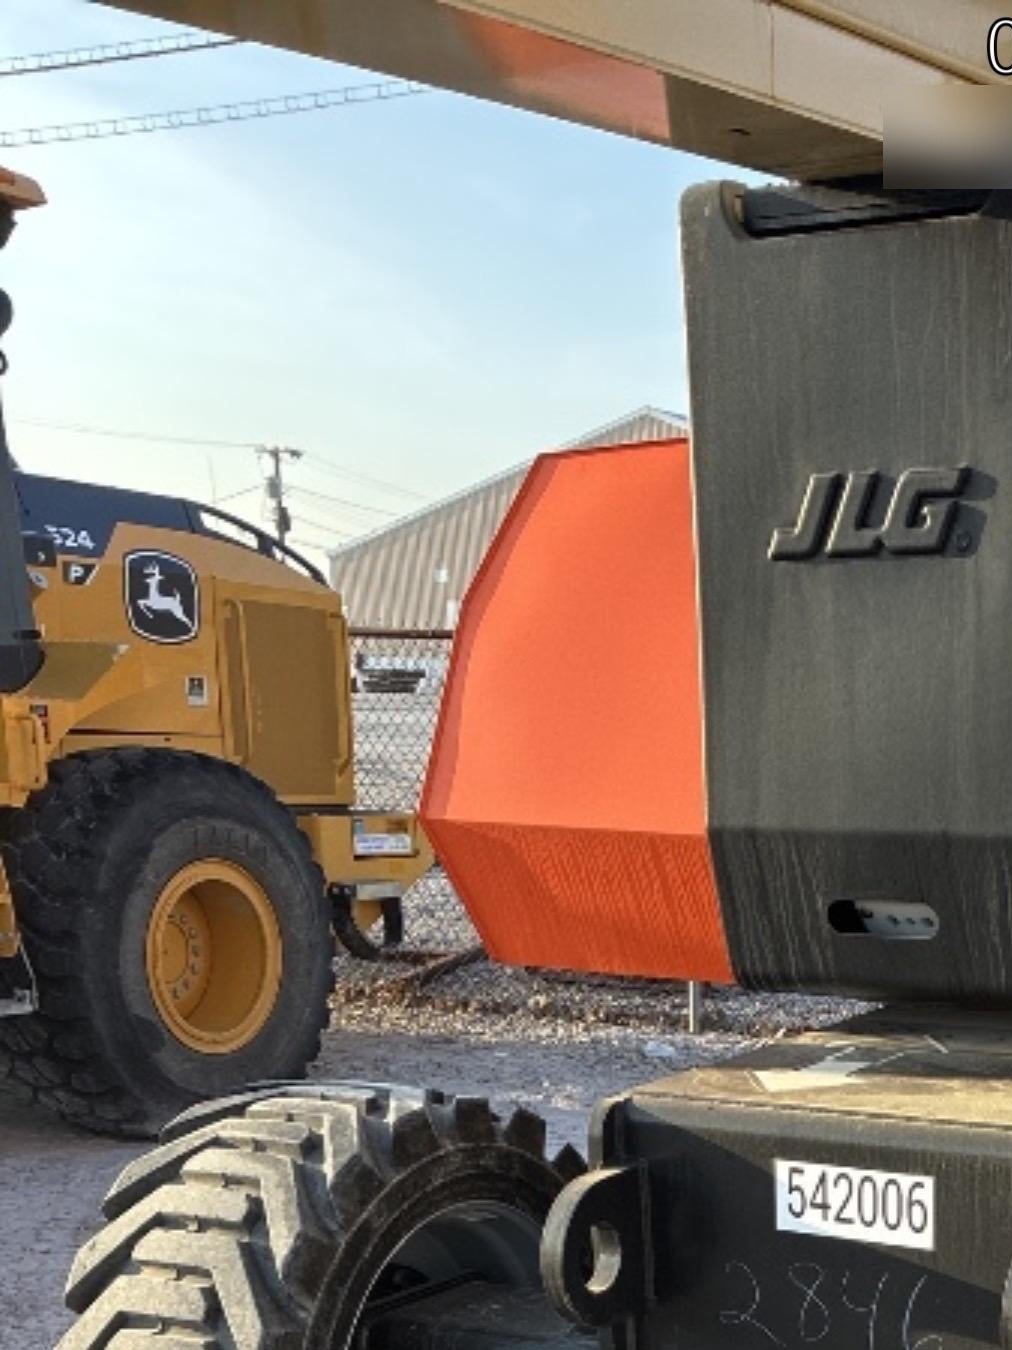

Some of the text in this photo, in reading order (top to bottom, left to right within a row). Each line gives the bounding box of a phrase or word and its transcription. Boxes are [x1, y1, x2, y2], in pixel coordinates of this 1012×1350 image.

[767, 462, 974, 560] JLG
[69, 564, 84, 582] P
[787, 1166, 929, 1234] 542006
